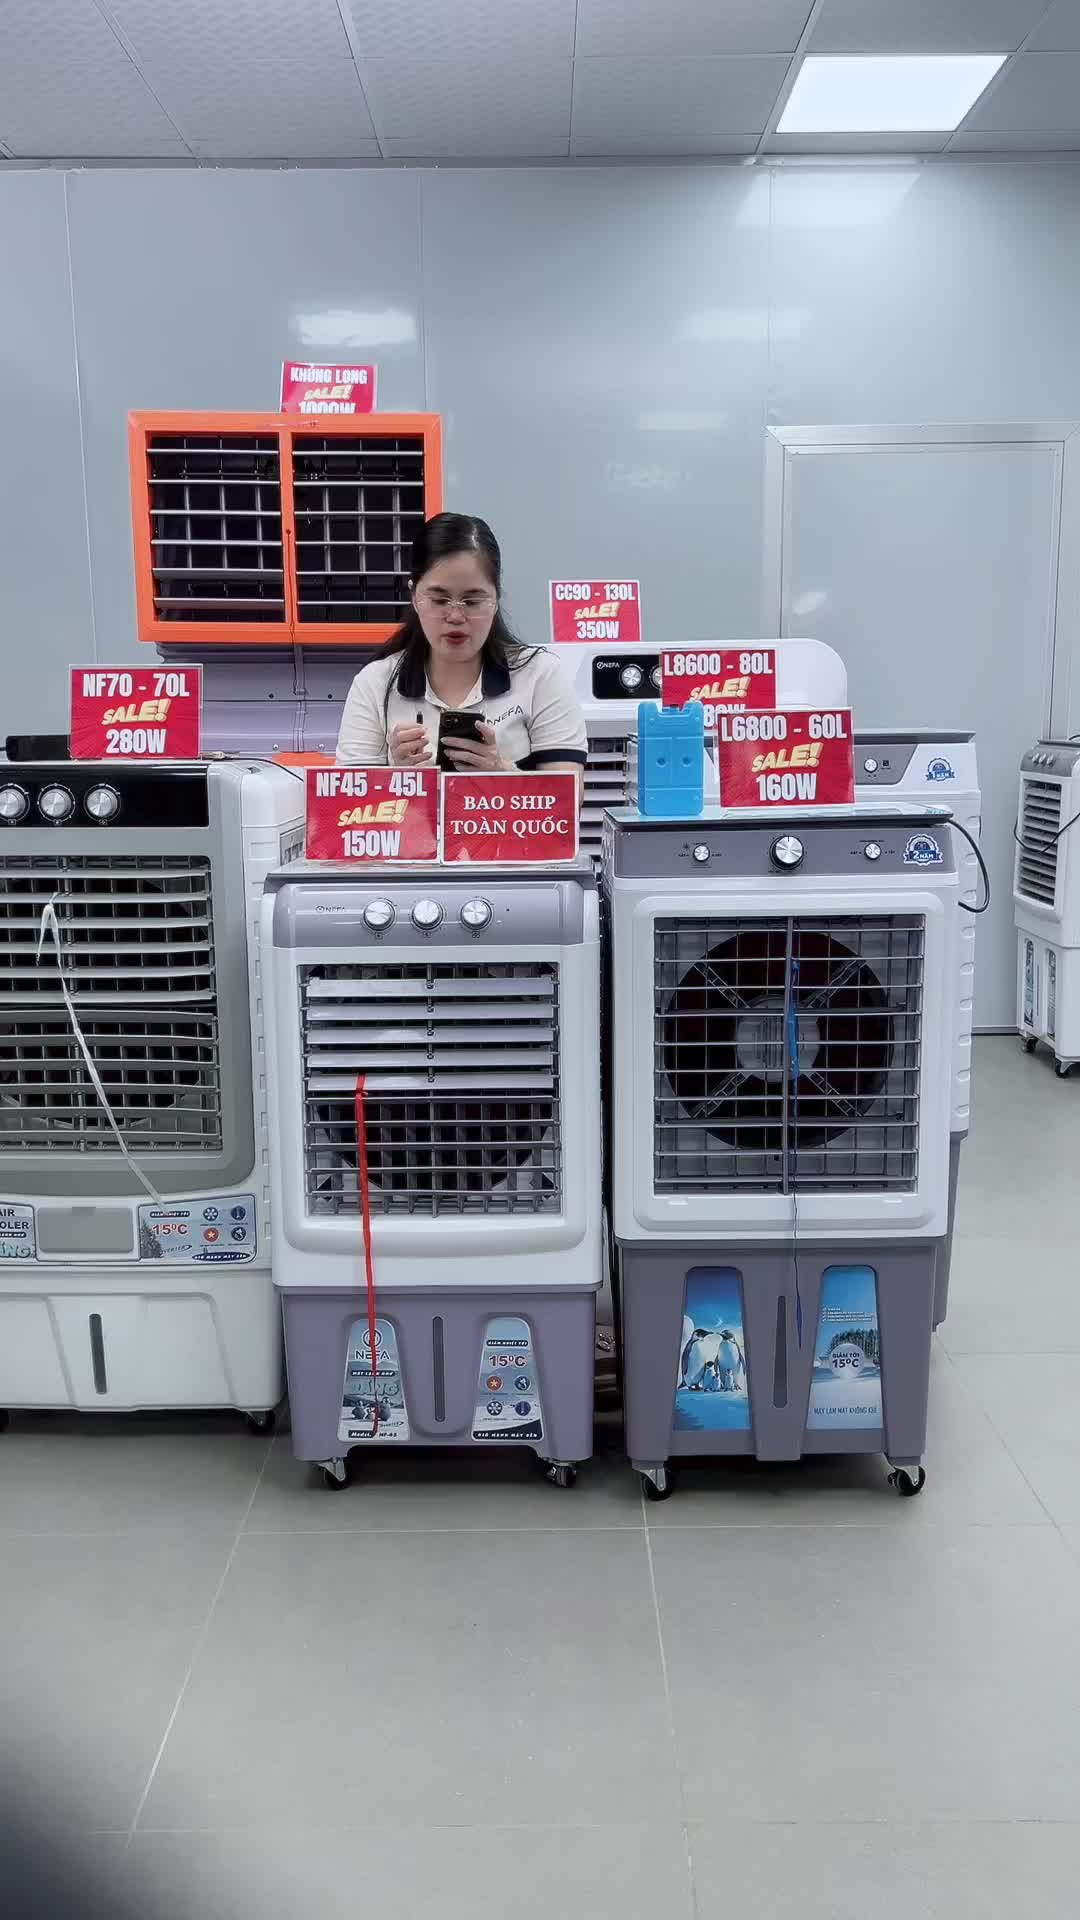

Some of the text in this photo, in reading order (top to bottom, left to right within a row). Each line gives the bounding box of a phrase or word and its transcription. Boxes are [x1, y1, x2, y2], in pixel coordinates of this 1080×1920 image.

[336, 369, 368, 384] LONG
[303, 385, 353, 401] SALE!
[555, 584, 591, 600] CC90
[603, 584, 635, 600] 130L
[574, 602, 619, 619] SALE!
[577, 621, 619, 638] 350W
[664, 653, 721, 676] L8600
[739, 652, 773, 675] 80L
[83, 673, 132, 697] NF70
[153, 673, 190, 697] 70L
[689, 677, 751, 701] SALE!
[101, 698, 172, 726] SALE!
[721, 715, 787, 742] L6800
[808, 714, 847, 739] 60L
[105, 729, 167, 754] 280W
[751, 742, 824, 773] SALE!
[316, 772, 367, 797] NF45
[389, 772, 427, 797] 45L
[756, 773, 817, 801] 160W
[337, 799, 409, 827] SALE!
[464, 795, 556, 810] BAO SHIP
[451, 815, 569, 837] TOÀN QUỐC
[341, 831, 400, 857] 150W
[913, 851, 919, 859] 2
